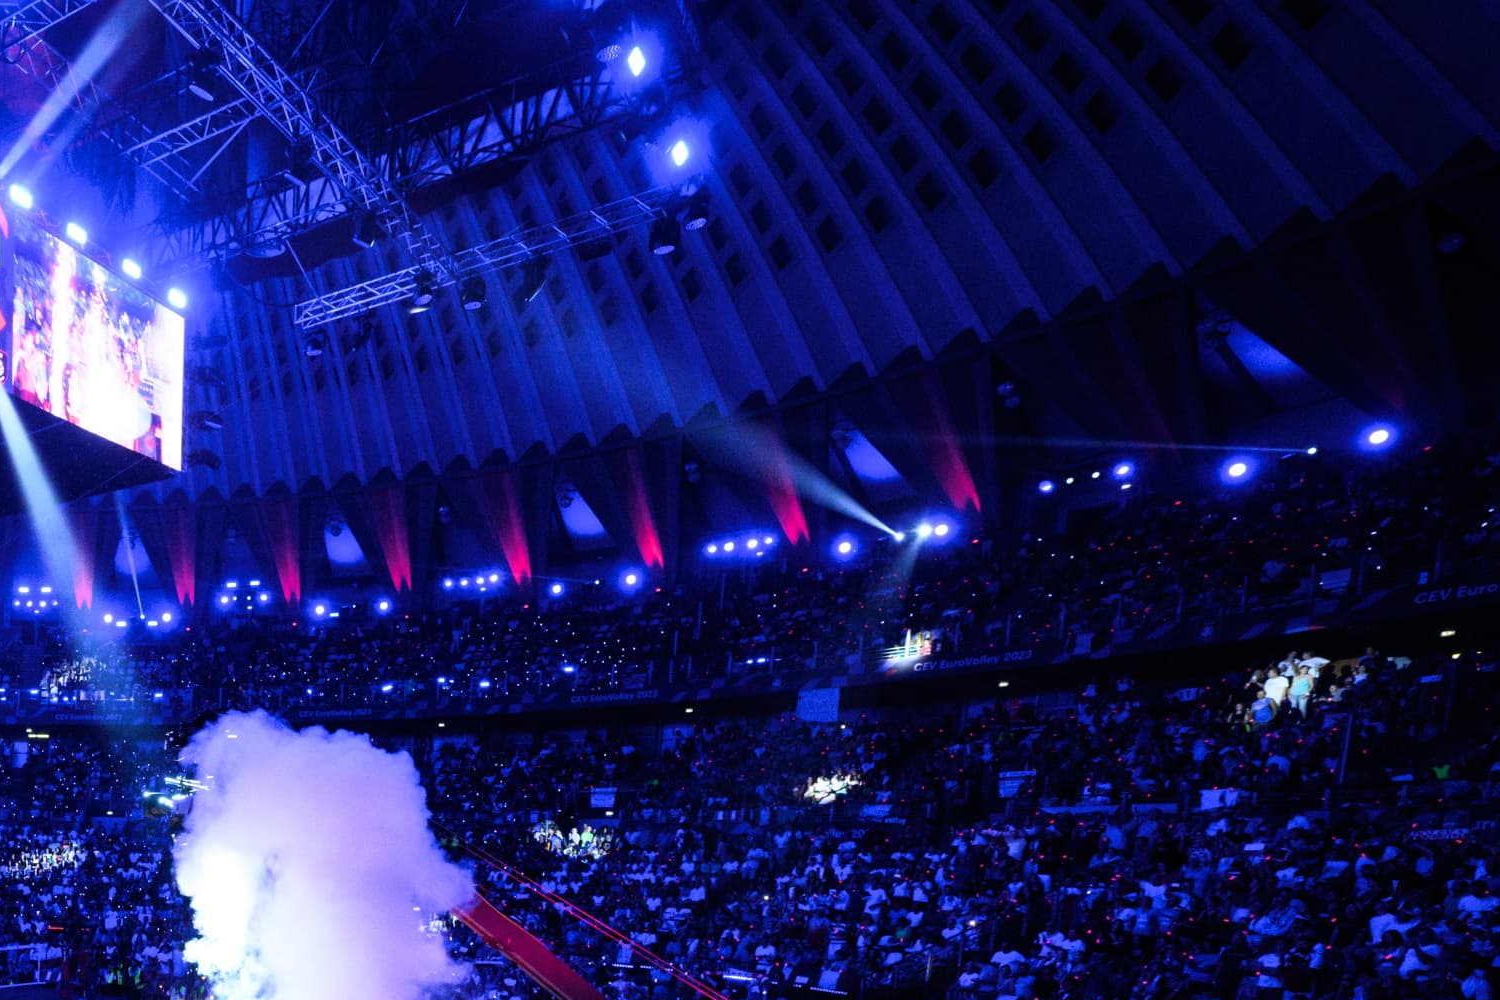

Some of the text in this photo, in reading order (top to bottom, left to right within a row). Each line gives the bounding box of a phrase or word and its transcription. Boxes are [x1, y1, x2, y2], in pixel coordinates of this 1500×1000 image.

[1413, 587, 1453, 604] CEV
[913, 649, 1034, 672] CEV EuroVolley 2023
